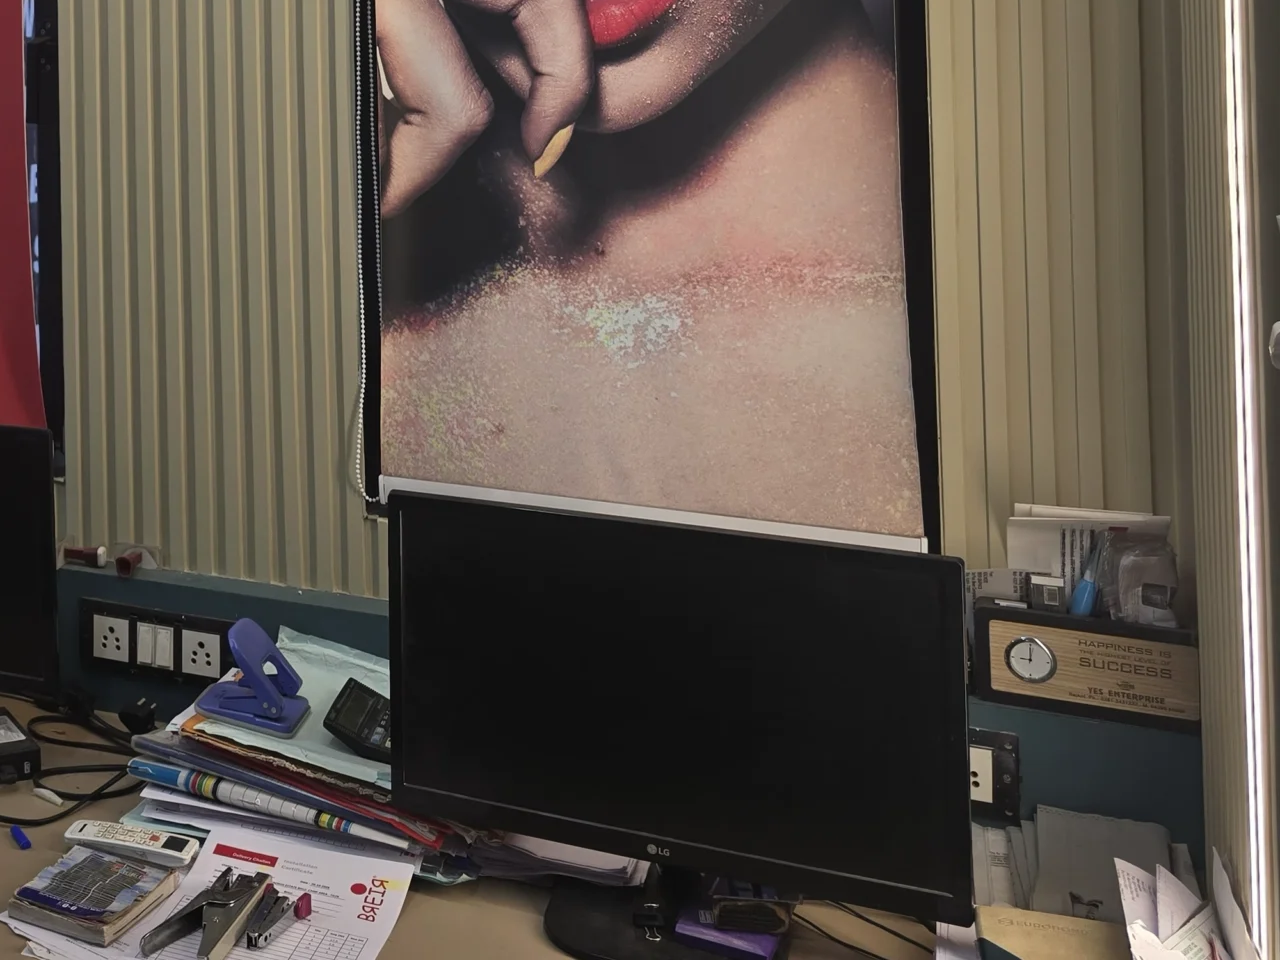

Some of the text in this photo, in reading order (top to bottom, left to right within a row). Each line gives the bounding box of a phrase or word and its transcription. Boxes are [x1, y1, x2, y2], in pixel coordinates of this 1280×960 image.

[1078, 639, 1172, 659] HAPPINESS IS
[1079, 656, 1172, 679] SUCCESS
[1087, 686, 1104, 696] YES
[1108, 690, 1166, 706] ENTERPRISE
[658, 847, 670, 856] LG
